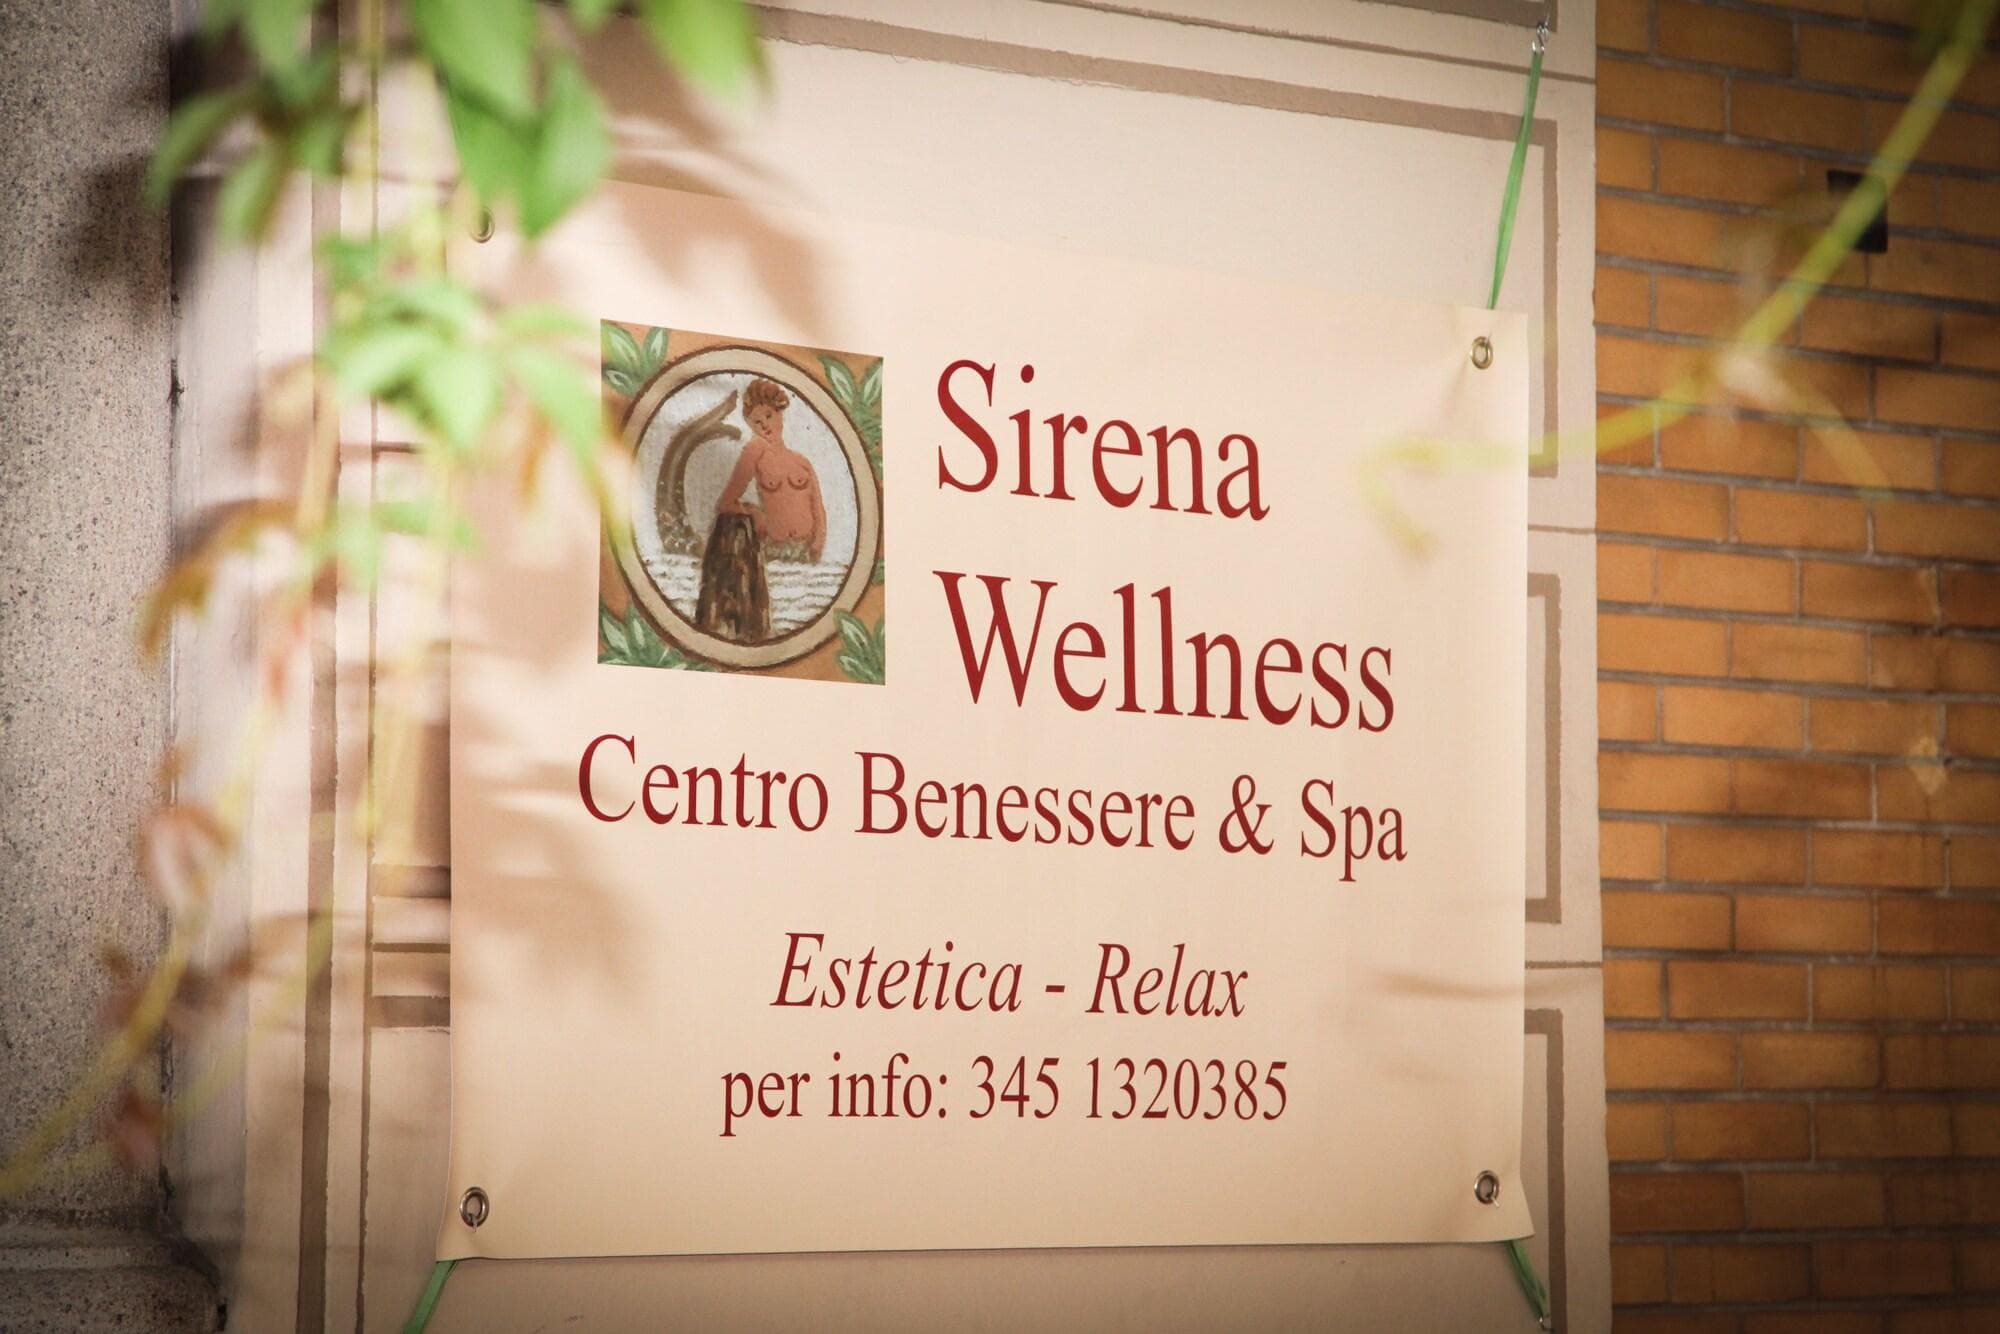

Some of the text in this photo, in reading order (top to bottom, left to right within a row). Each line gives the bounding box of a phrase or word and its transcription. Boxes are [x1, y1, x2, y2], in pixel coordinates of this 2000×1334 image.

[937, 359, 1271, 521] Sirena
[933, 570, 1395, 733] Wellness
[578, 734, 1408, 882] Centro Benessere & Spa
[771, 932, 1248, 1017] Estetica - Relax
[719, 1052, 1289, 1137] per info: 345 1320385
